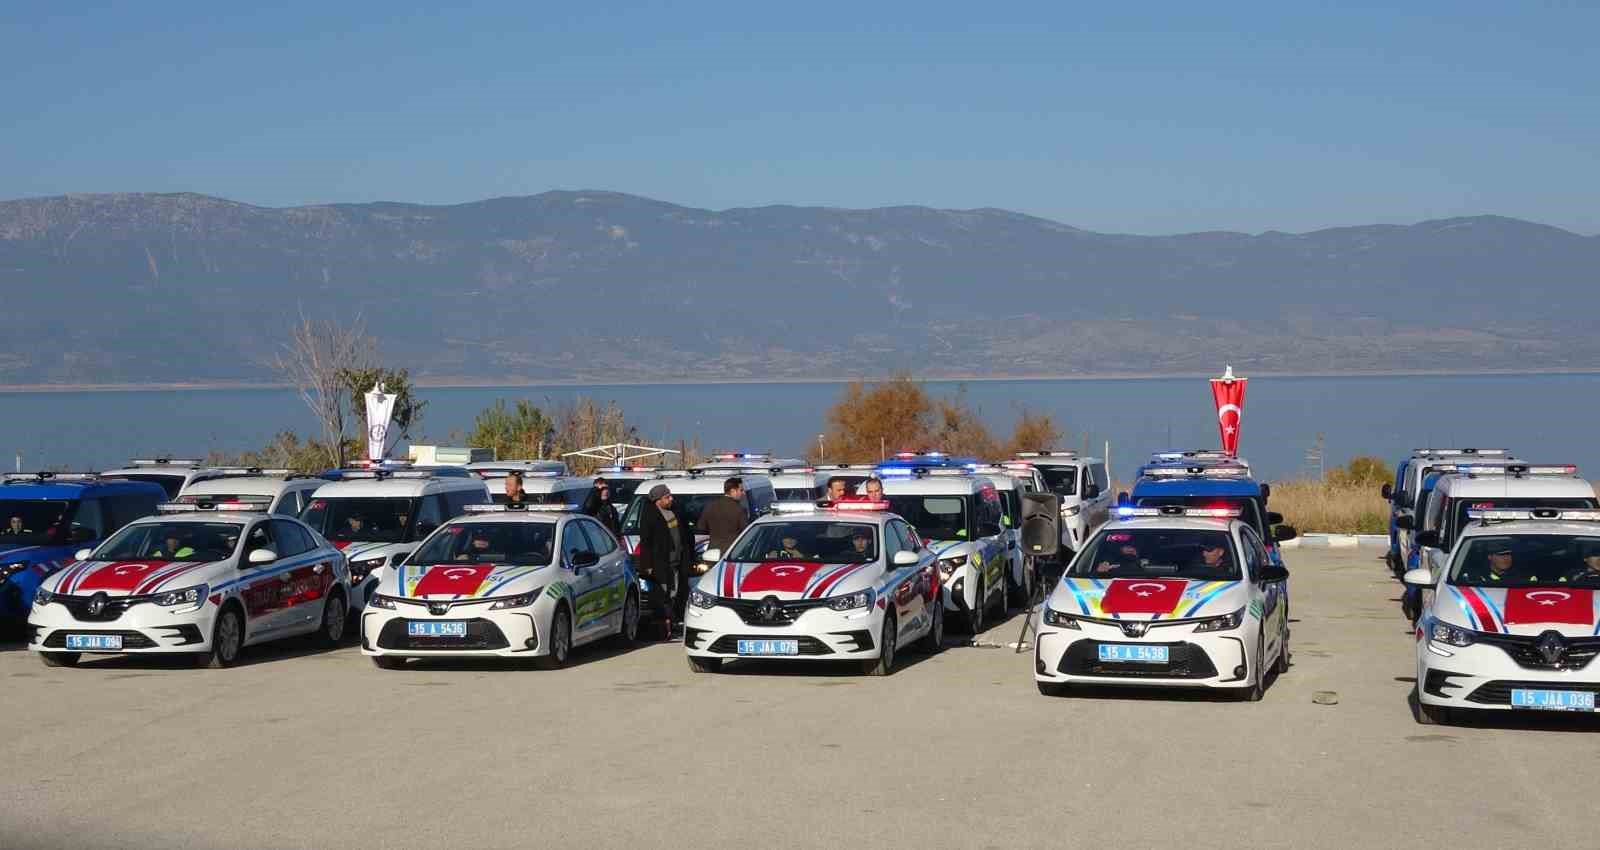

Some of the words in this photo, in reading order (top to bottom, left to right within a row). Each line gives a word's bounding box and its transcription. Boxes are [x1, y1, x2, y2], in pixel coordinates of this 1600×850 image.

[415, 623, 425, 634] 15
[73, 637, 82, 648] 15
[745, 641, 754, 653] 15
[1106, 647, 1119, 658] 15
[1125, 648, 1133, 659] A
[1522, 692, 1535, 705] 15
[1542, 693, 1564, 706] JAA
[1569, 694, 1592, 707] 036
